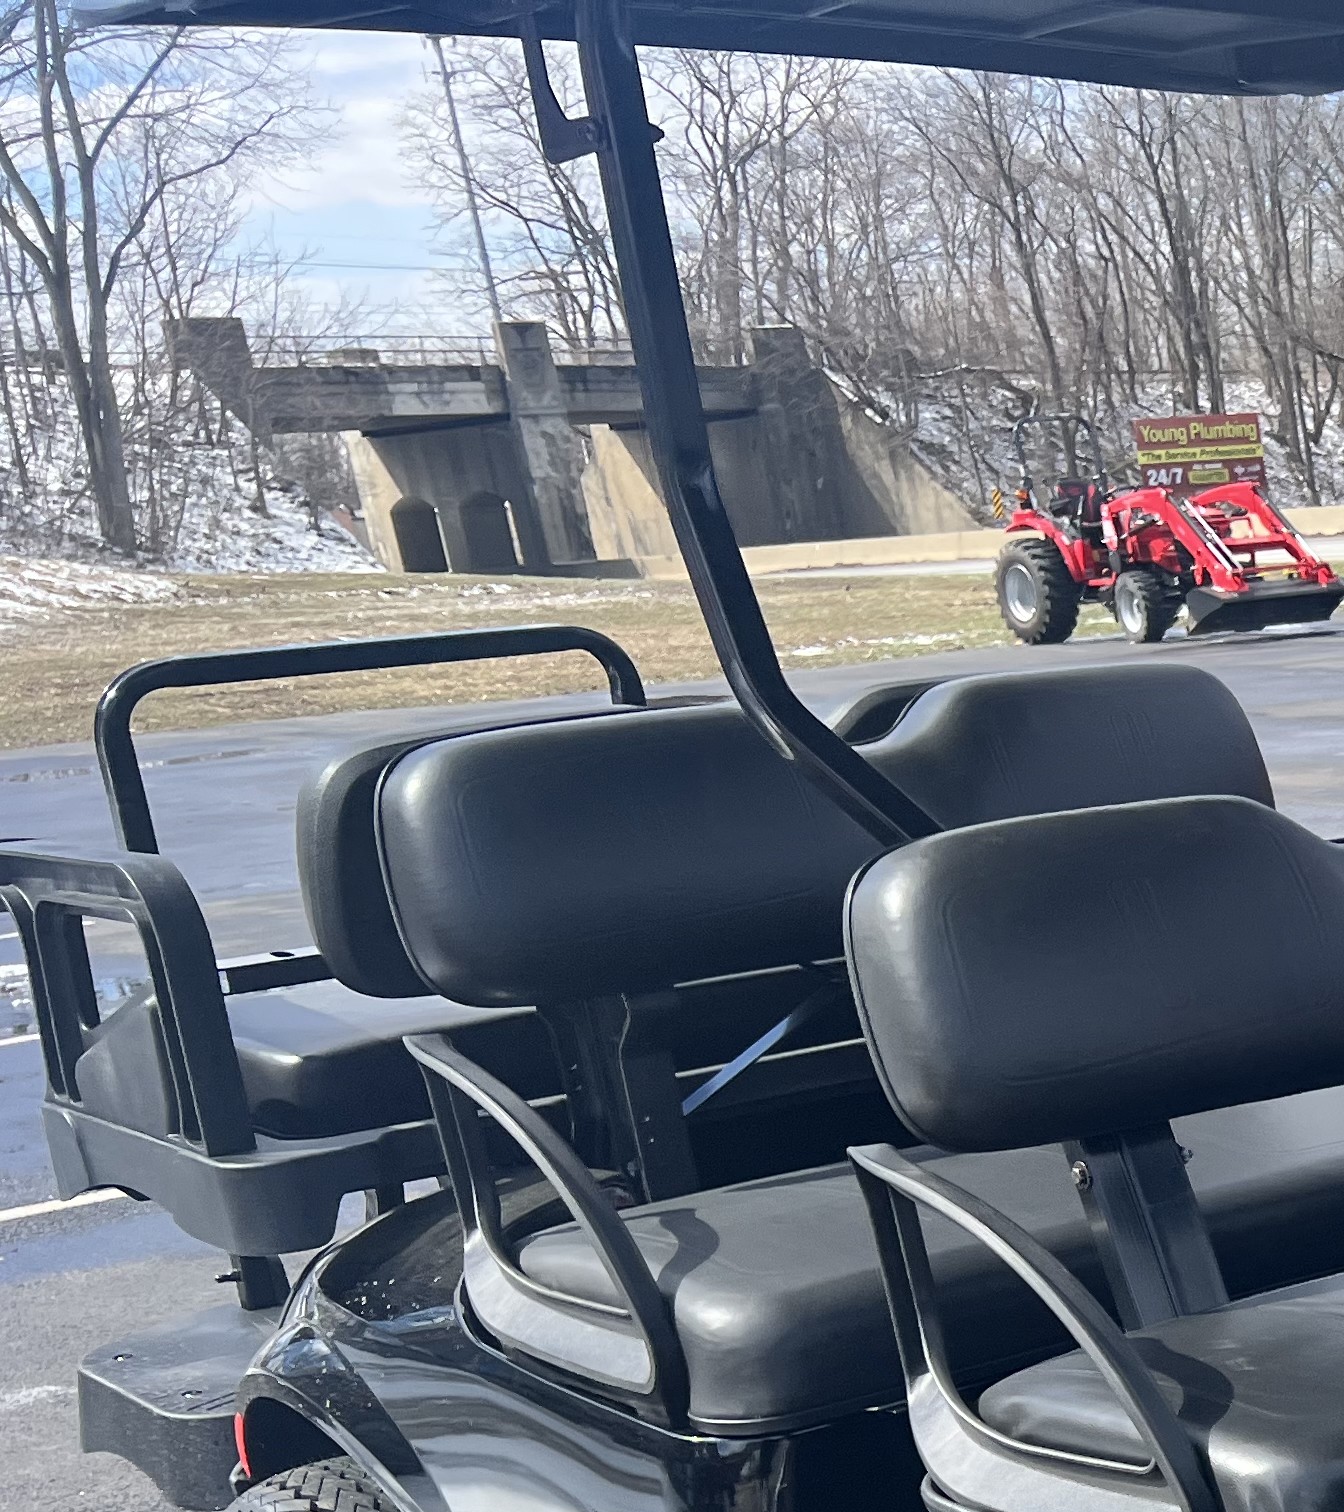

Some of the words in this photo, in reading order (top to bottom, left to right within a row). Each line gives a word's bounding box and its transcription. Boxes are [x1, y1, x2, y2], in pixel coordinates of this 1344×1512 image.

[1139, 425, 1188, 445] Young
[1189, 420, 1257, 441] Plumbing
[1147, 467, 1183, 486] 24/7
